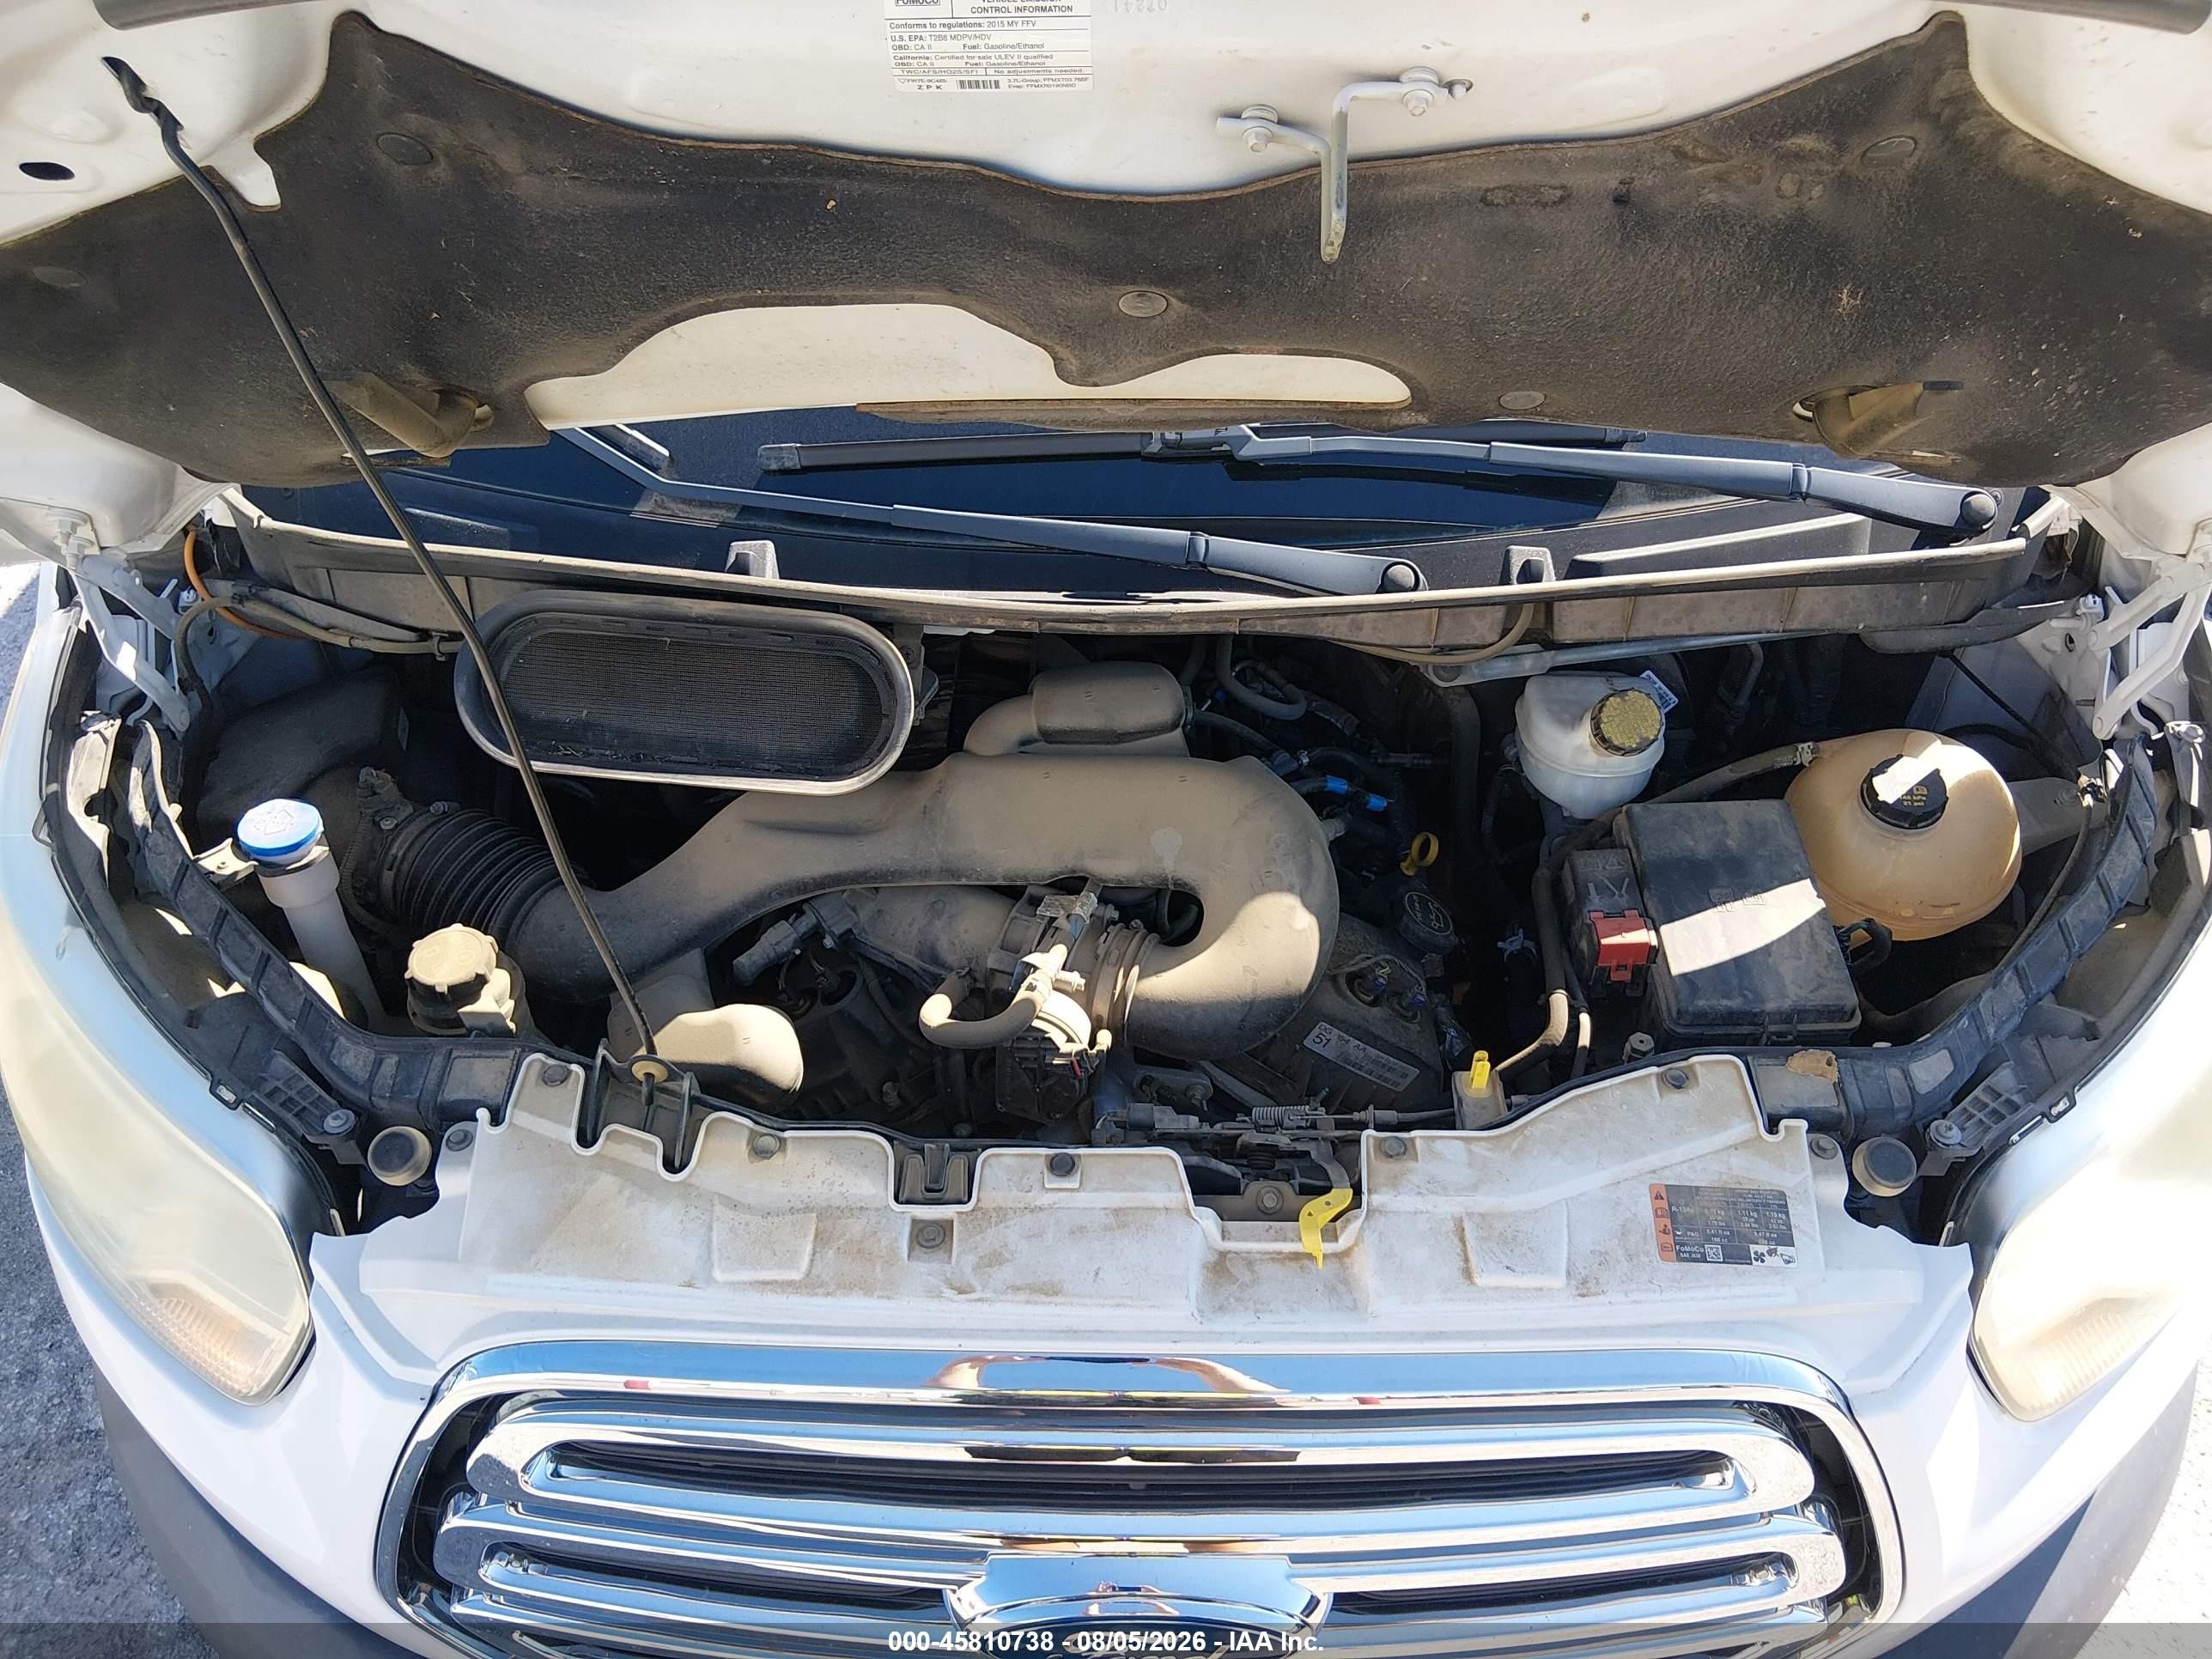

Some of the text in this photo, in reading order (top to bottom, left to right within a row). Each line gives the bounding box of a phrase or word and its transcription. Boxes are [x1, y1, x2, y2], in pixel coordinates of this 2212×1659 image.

[970, 5, 1073, 15] CONTROL INFORMATION
[939, 21, 985, 31] regulations:
[1312, 1031, 1332, 1048] 51
[1675, 1244, 1705, 1253] FoMoCo
